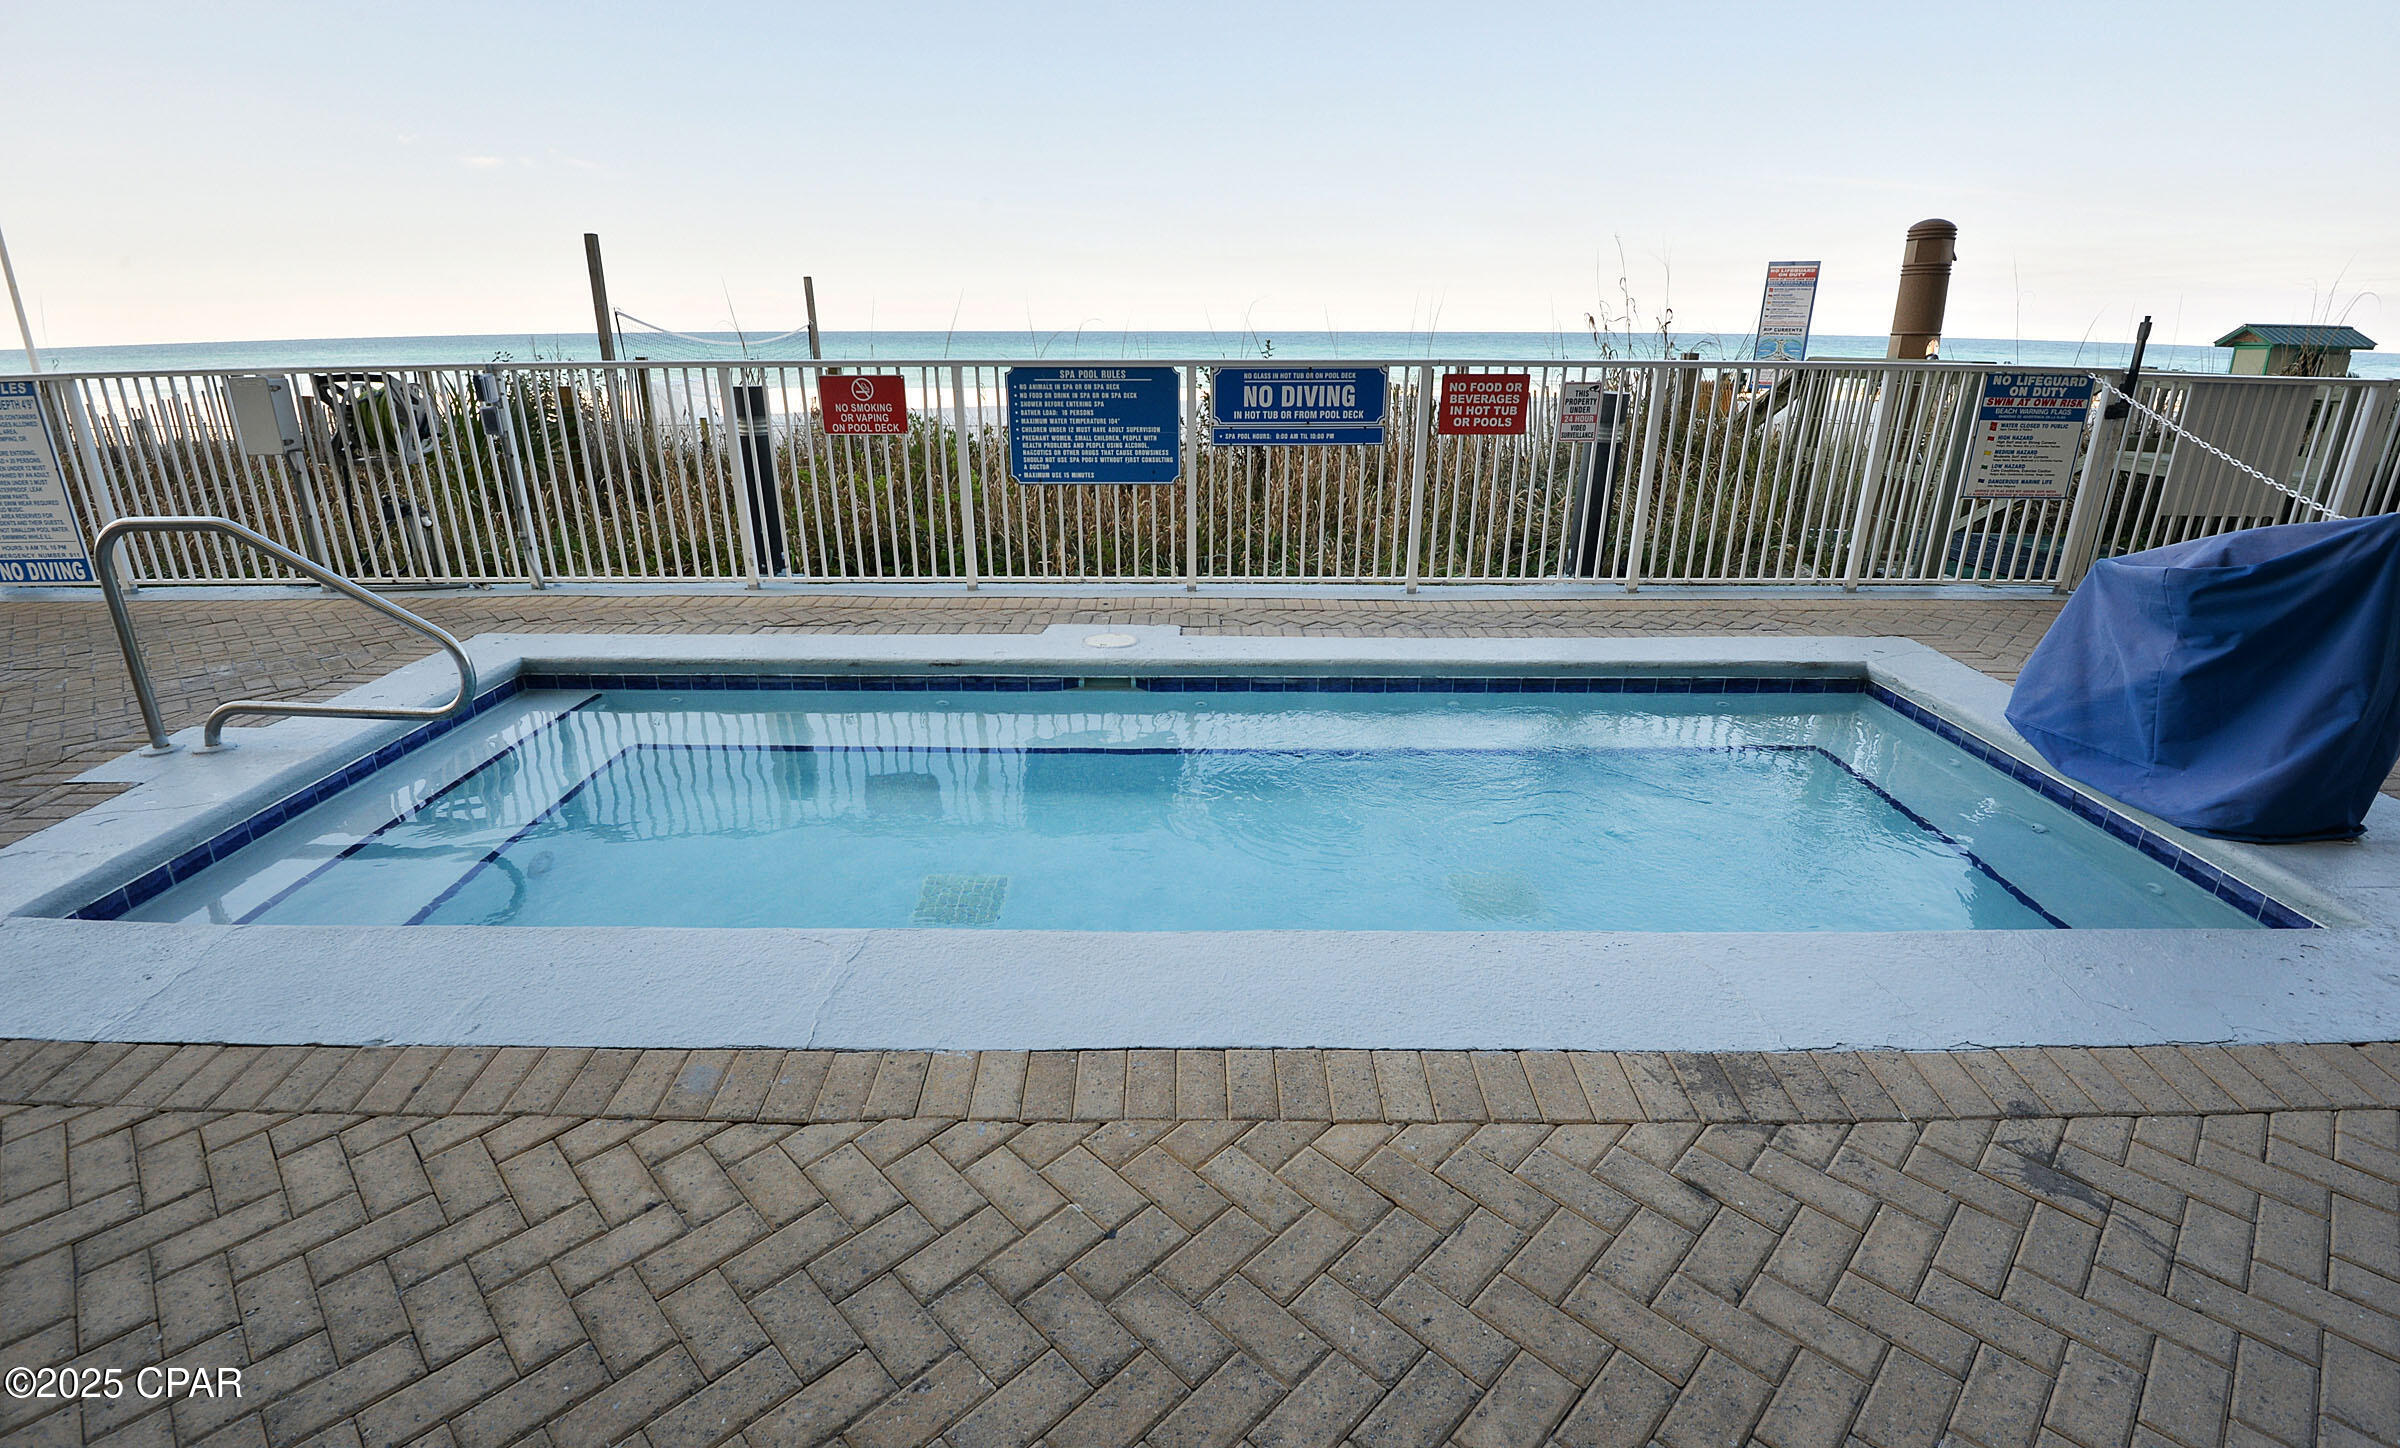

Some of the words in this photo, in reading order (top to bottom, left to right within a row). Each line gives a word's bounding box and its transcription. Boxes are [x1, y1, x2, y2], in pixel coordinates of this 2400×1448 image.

[1060, 370, 1074, 380] SPA
[1078, 370, 1097, 380] POOL
[1101, 370, 1126, 380] RULES
[1993, 376, 2012, 385] NO
[2016, 376, 2088, 386] LIFEGUARD
[1450, 383, 1466, 392] NO
[1470, 383, 1502, 392] FOOD
[1506, 383, 1522, 392] OR
[2009, 387, 2028, 396] ON
[2032, 387, 2067, 397] DUTY
[1244, 386, 1272, 407] NO
[1282, 386, 1355, 406] DIVING
[1450, 394, 1519, 403] BEVERAGES
[1987, 398, 2014, 406] SWIM
[2017, 398, 2030, 407] AT
[2034, 398, 2056, 407] OWN
[2060, 399, 2083, 408] RISK
[836, 404, 848, 412] NO
[851, 404, 892, 412] SMOKING
[1450, 406, 1462, 415] IN
[1466, 406, 1490, 415] HOT
[1494, 406, 1517, 415] TUB
[841, 414, 854, 422] OR
[856, 414, 888, 422] VAPING
[1281, 411, 1291, 419] OR
[1454, 418, 1470, 426] OR
[1474, 418, 1512, 426] POOLS
[848, 424, 872, 432] POOL
[875, 424, 899, 432] DECK
[0, 563, 25, 580] NO
[26, 562, 86, 580] DIVING
